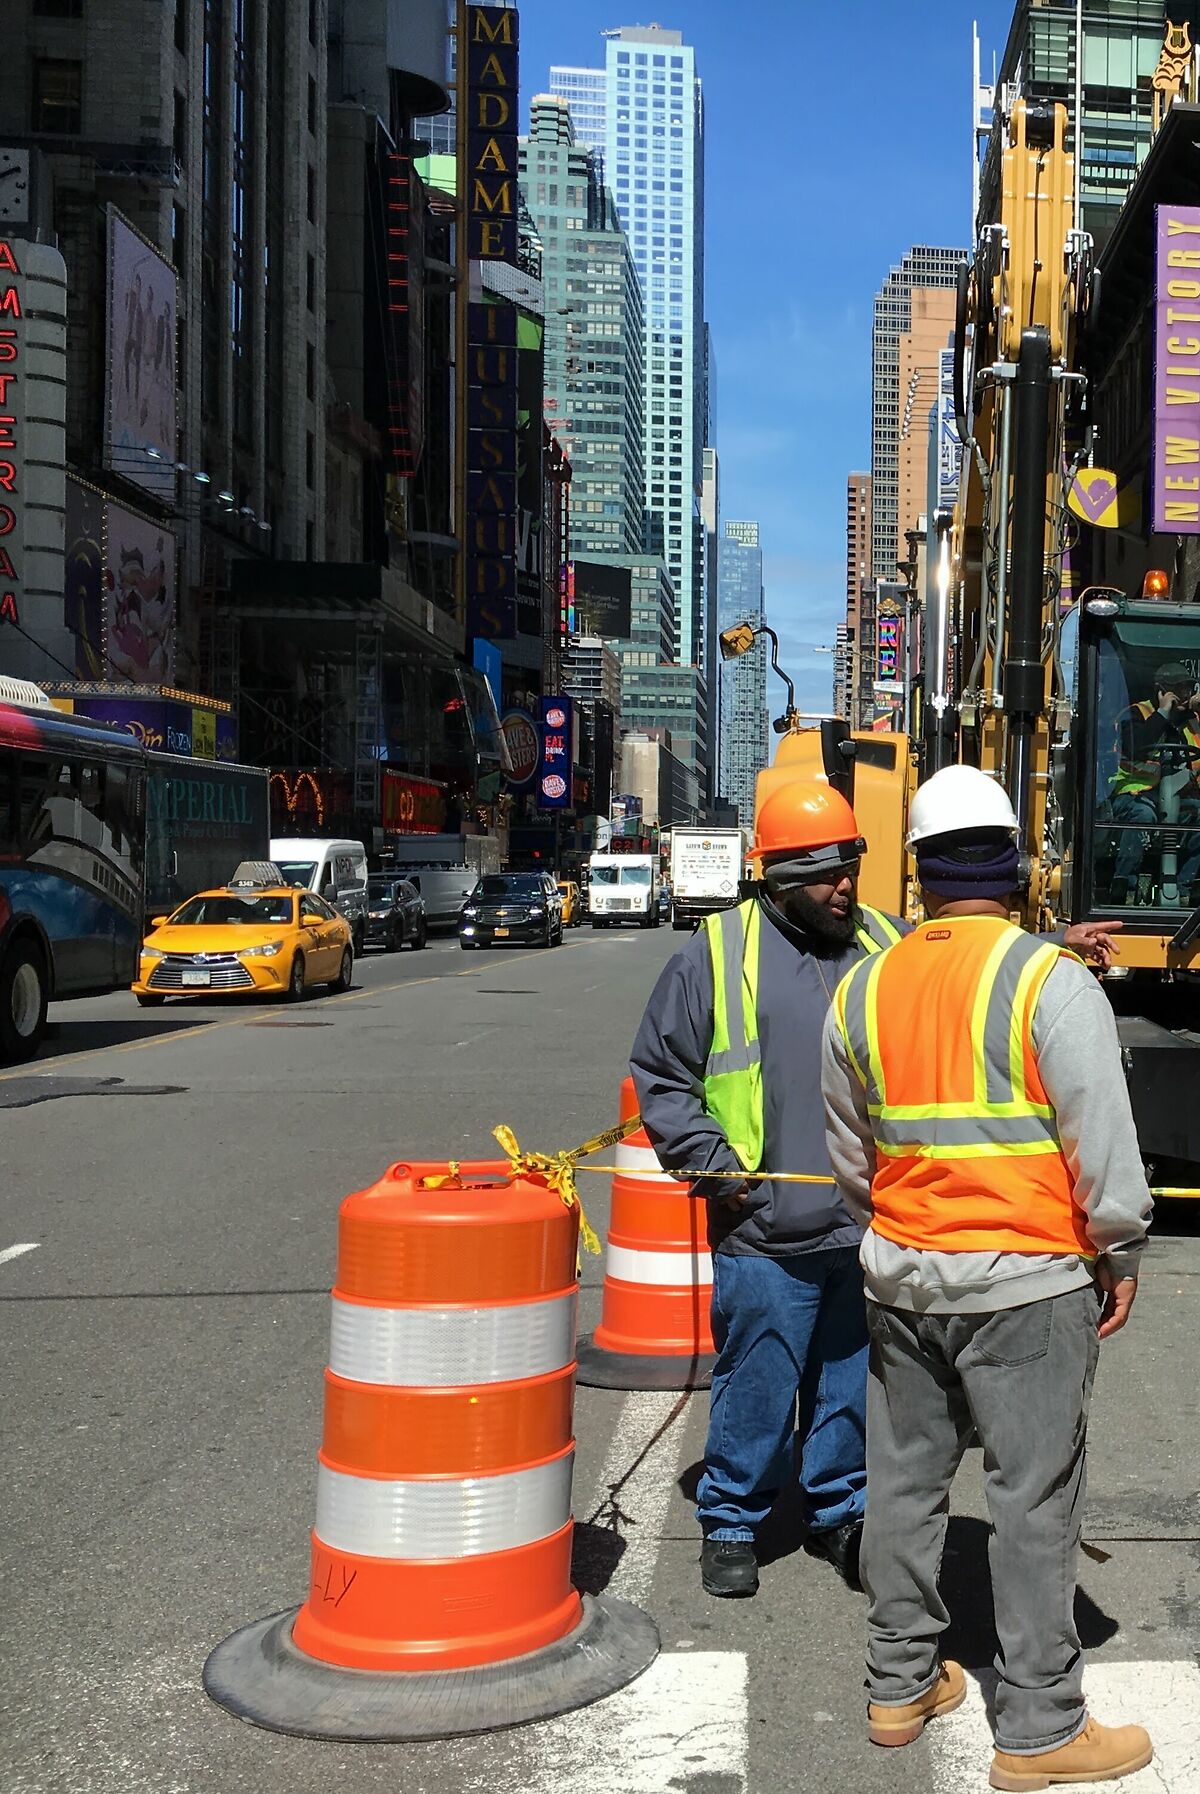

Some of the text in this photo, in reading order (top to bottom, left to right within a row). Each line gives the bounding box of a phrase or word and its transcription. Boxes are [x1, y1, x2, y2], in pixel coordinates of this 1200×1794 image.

[472, 8, 515, 258] MADAME
[1164, 436, 1200, 522] NEW
[167, 726, 192, 753] FROZEN
[149, 776, 254, 825] MPERIAL
